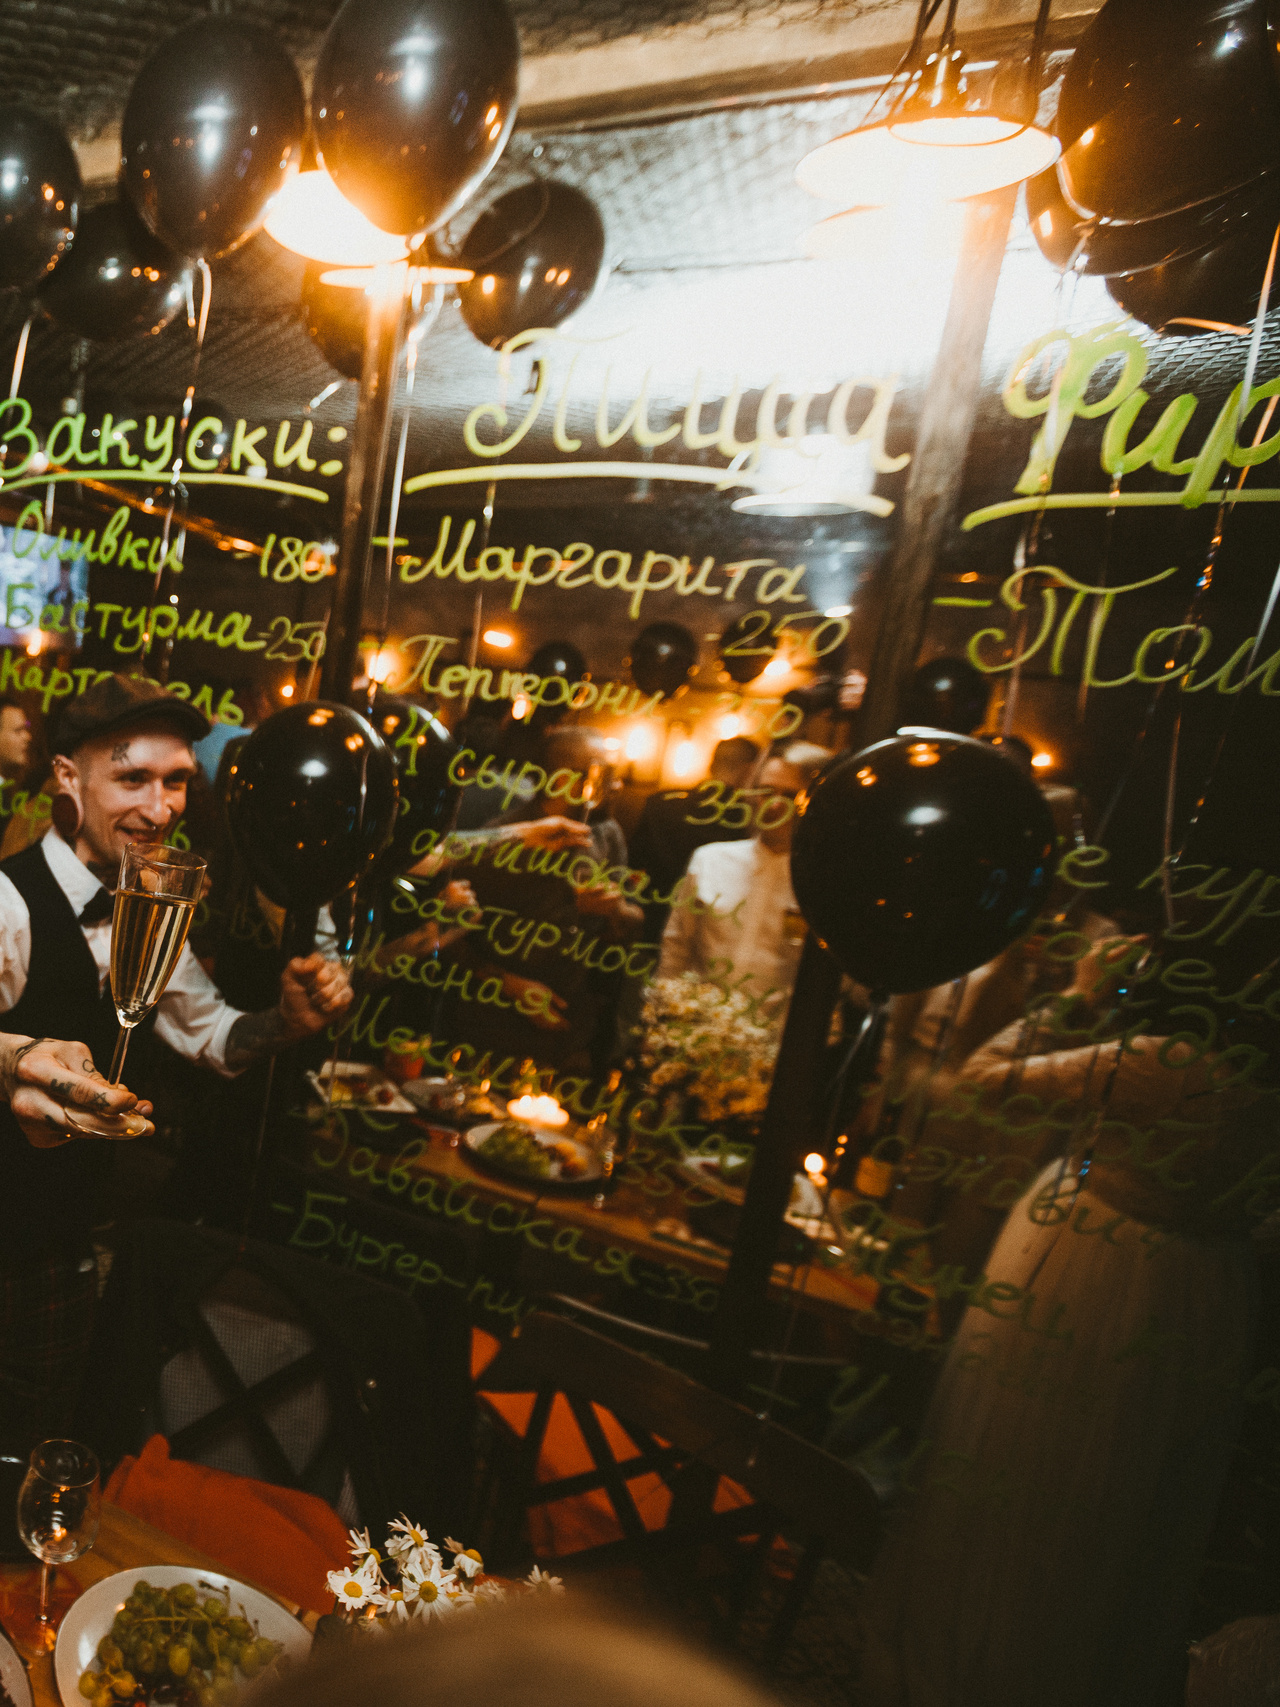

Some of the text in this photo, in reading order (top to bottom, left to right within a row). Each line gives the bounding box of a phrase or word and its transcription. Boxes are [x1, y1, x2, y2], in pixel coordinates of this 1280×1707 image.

[462, 327, 911, 474] Пицца
[447, 748, 588, 810] сыра
[354, 925, 561, 1023] Мясная
